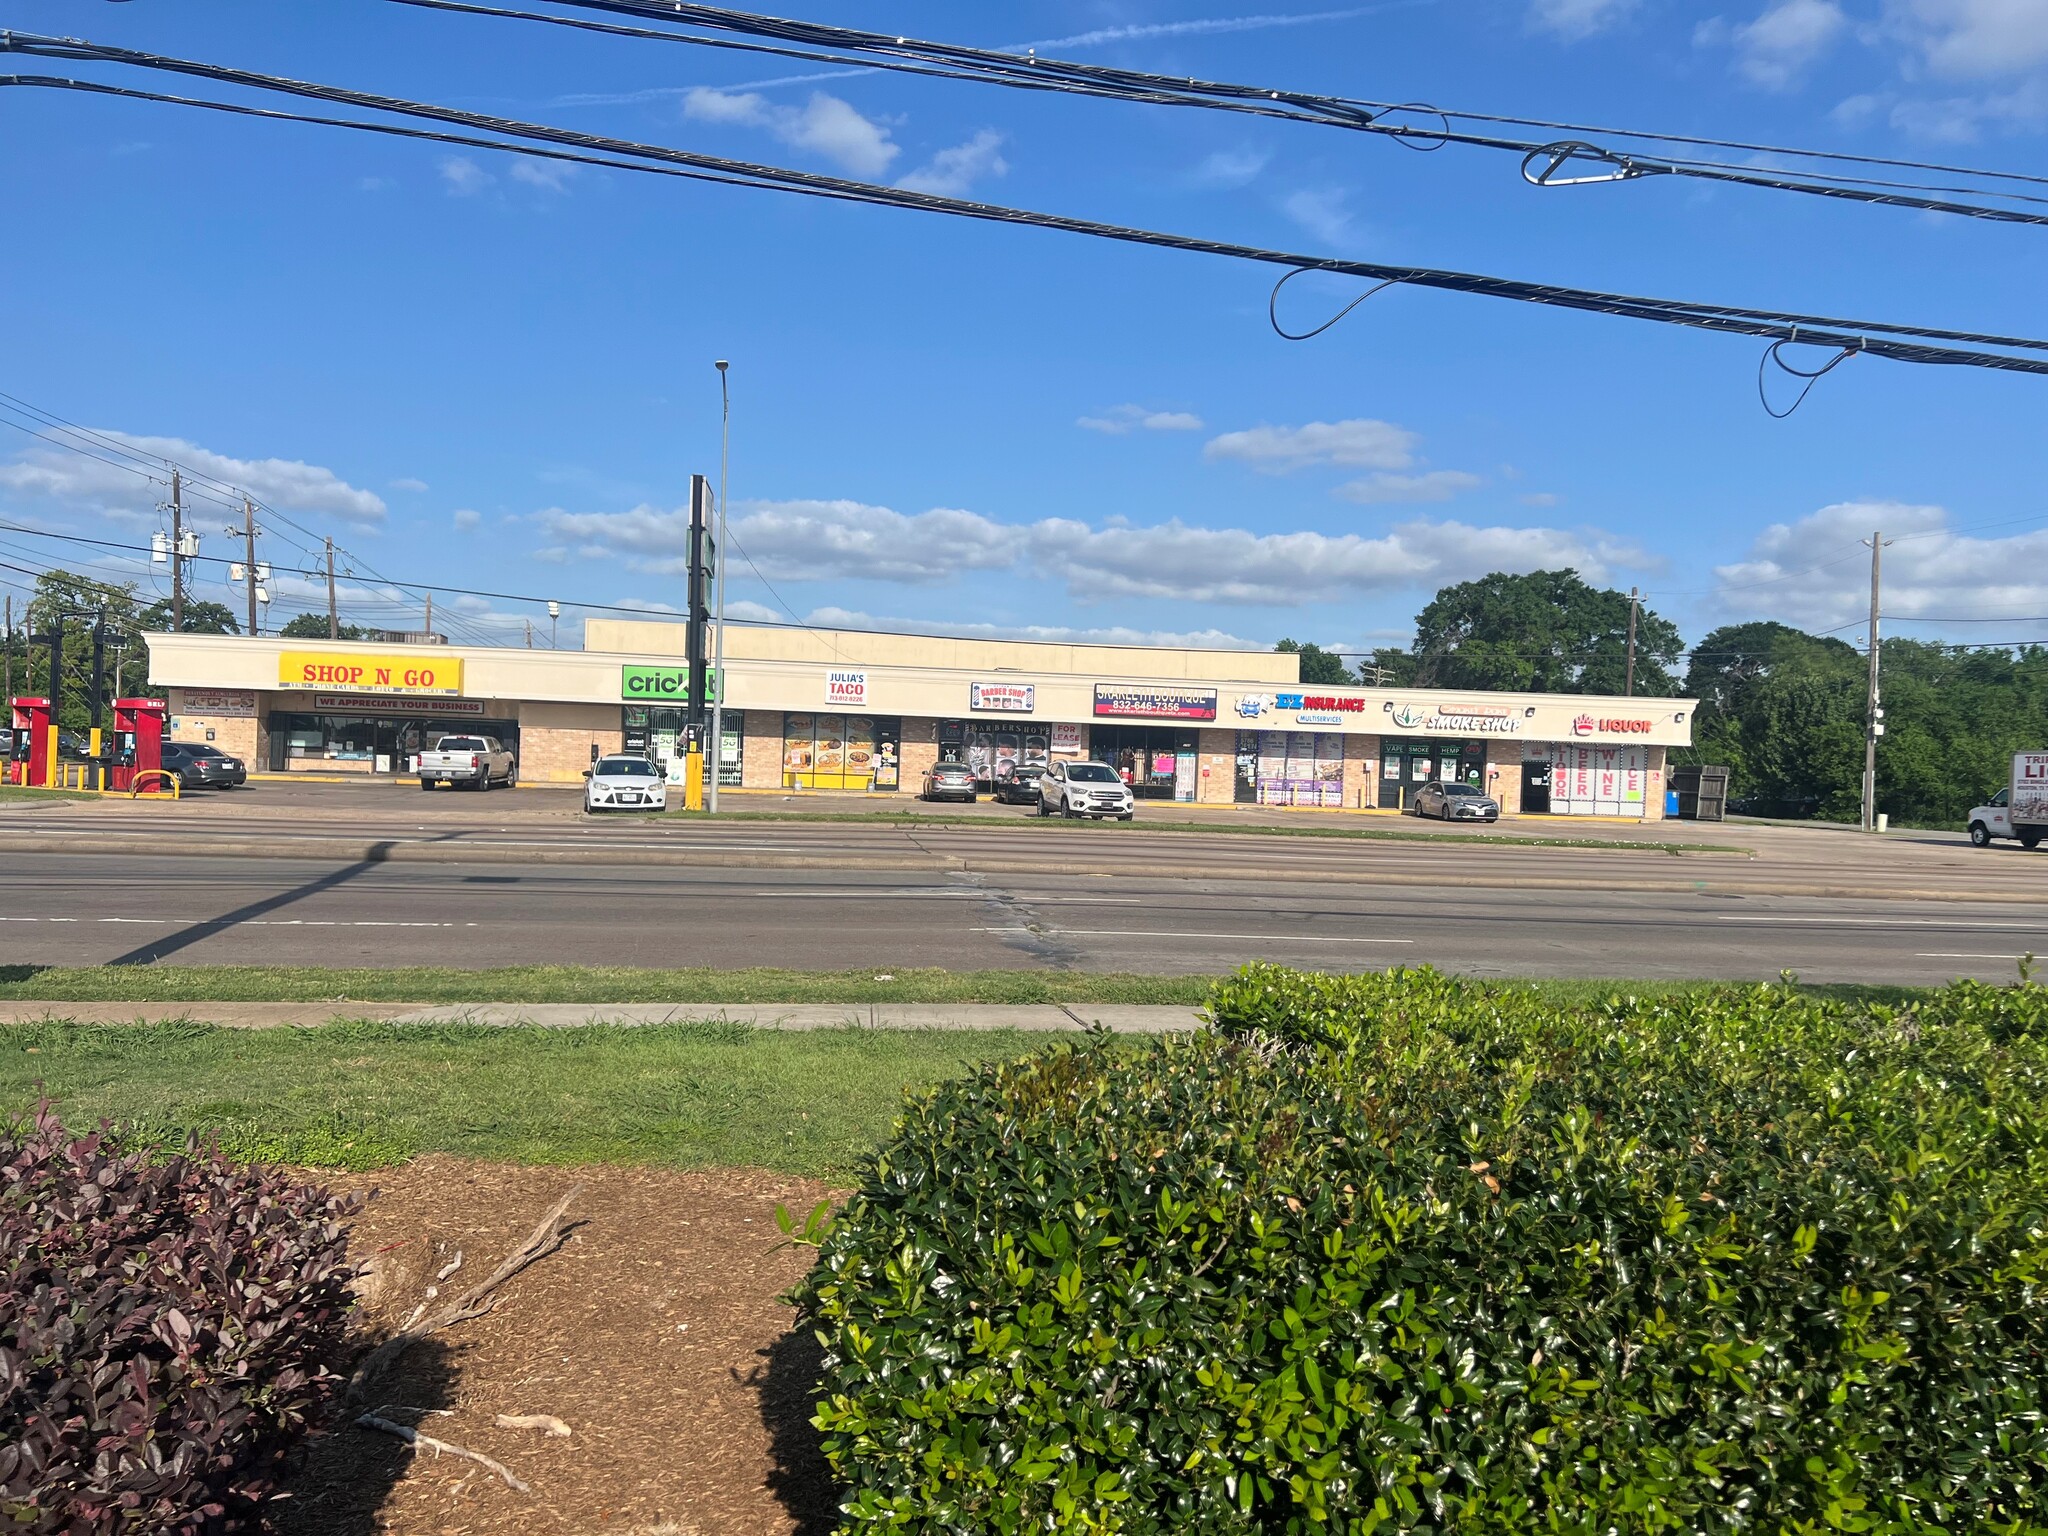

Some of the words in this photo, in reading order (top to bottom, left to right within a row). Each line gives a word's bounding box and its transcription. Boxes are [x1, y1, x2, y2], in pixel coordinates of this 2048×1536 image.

[303, 664, 363, 683] SHOP
[375, 668, 392, 685] N
[404, 670, 435, 687] GO
[830, 673, 864, 683] JULIA'S
[829, 683, 864, 695] TACO
[981, 687, 1007, 697] BARBER
[1008, 688, 1026, 698] SHOP
[1153, 688, 1206, 704] BOUTIQUE
[320, 697, 336, 706] WE
[338, 698, 398, 708] APPRECIATE
[399, 700, 429, 709] YOUR
[431, 701, 480, 711] BUSINESS
[1112, 700, 1180, 711] 832-646-7356
[1304, 696, 1365, 712] INSURANCE
[1300, 715, 1342, 723] MULTISERVICES
[1426, 715, 1482, 731] SMOKE
[1481, 717, 1522, 733] SHOP
[1599, 719, 1653, 733] LIQUOR
